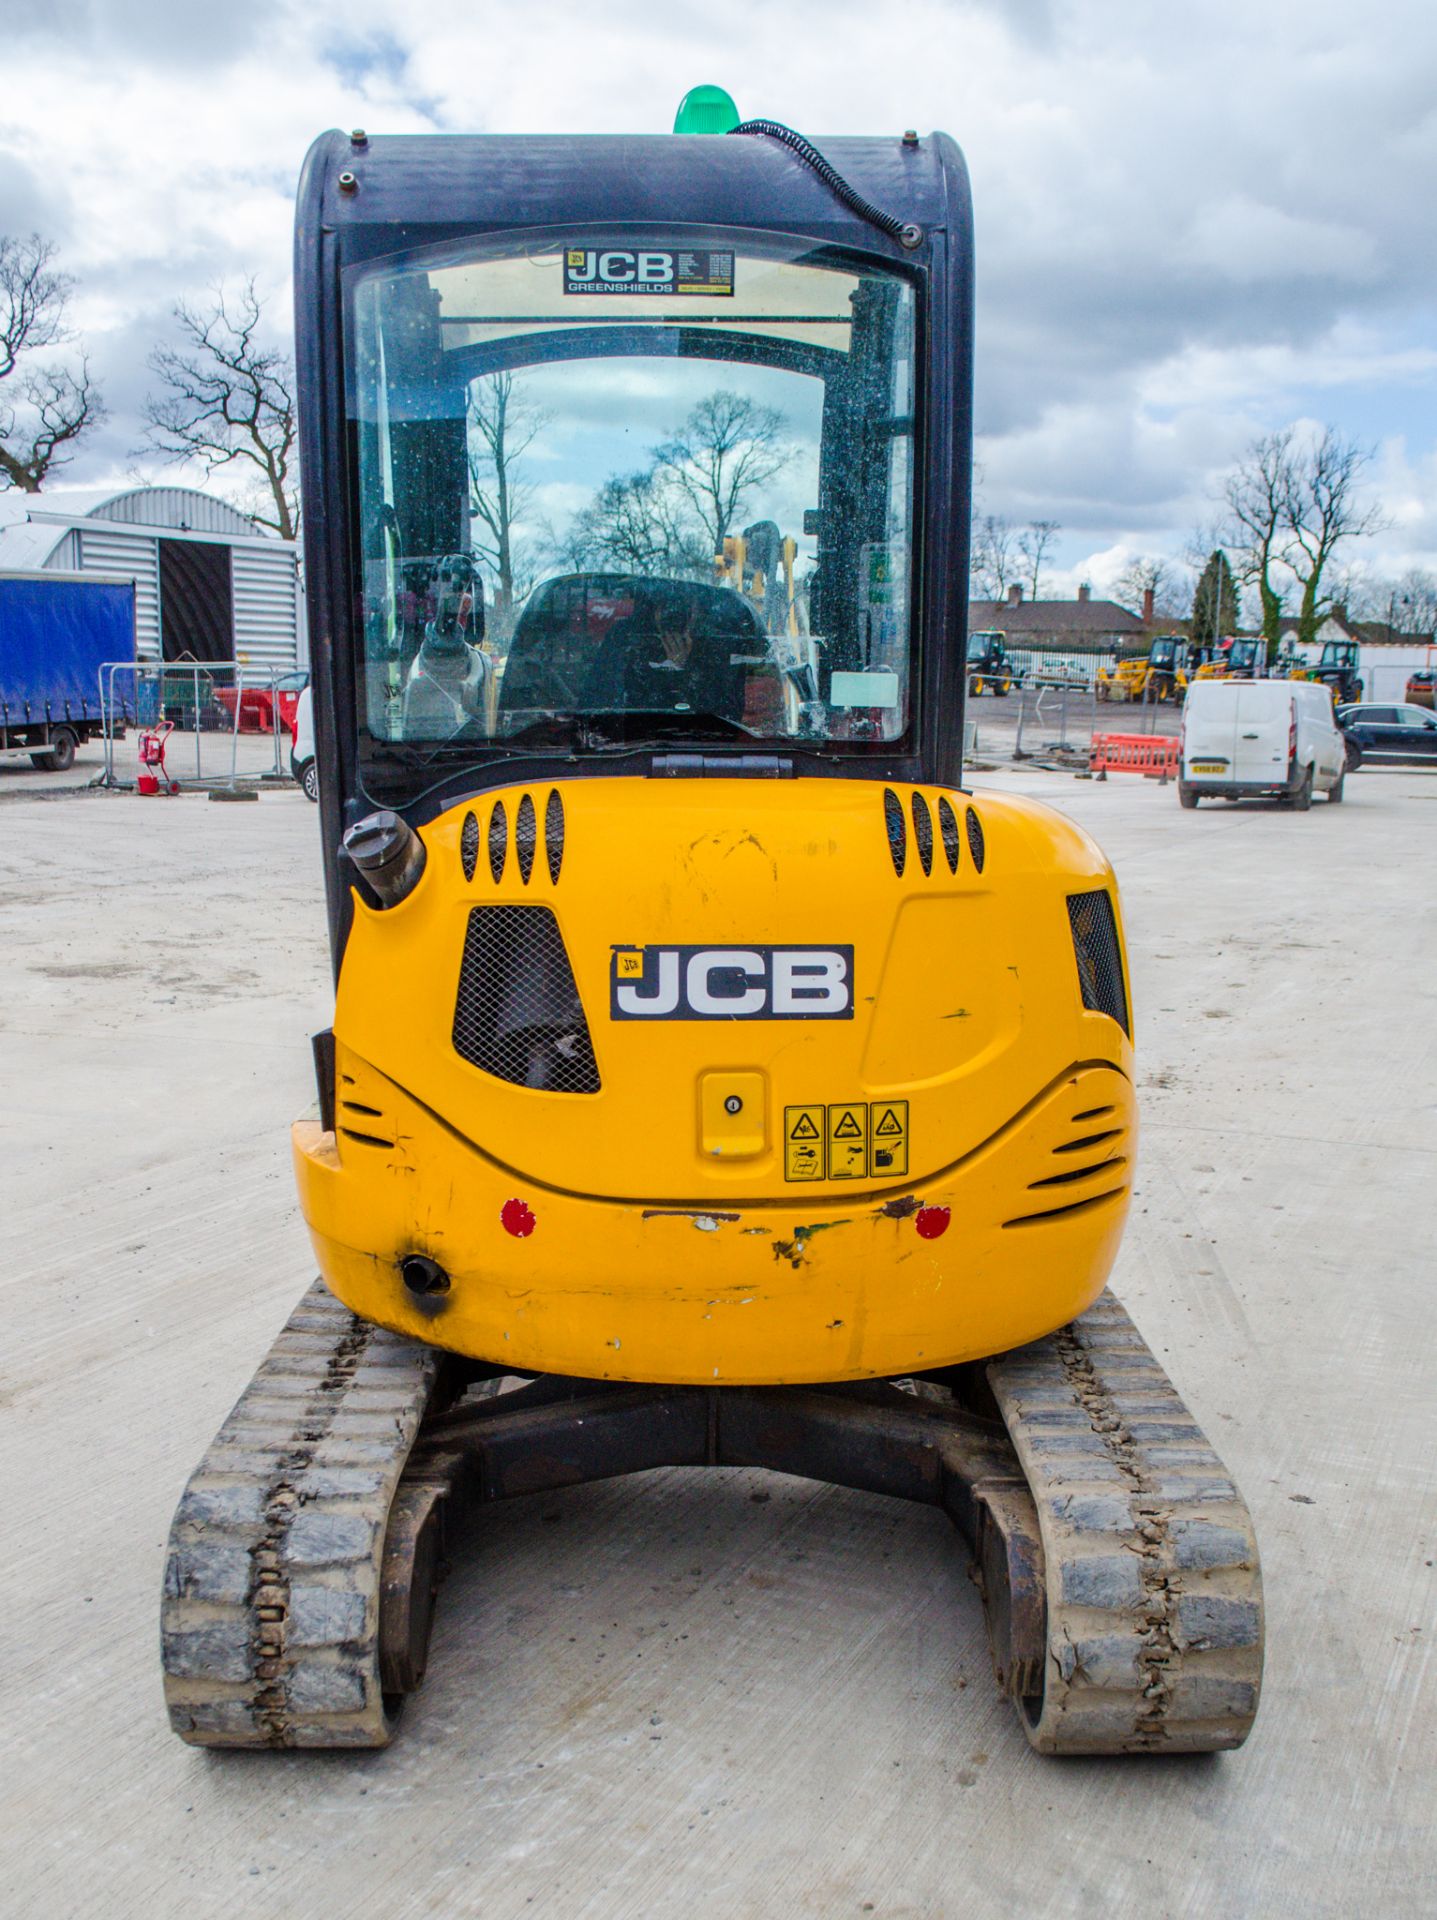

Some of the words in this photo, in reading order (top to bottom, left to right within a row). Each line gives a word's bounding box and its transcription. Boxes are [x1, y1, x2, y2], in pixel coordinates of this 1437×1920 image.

[568, 252, 674, 283] JCB
[568, 283, 673, 293] GREENSHIELDS
[617, 951, 849, 1014] JCB
